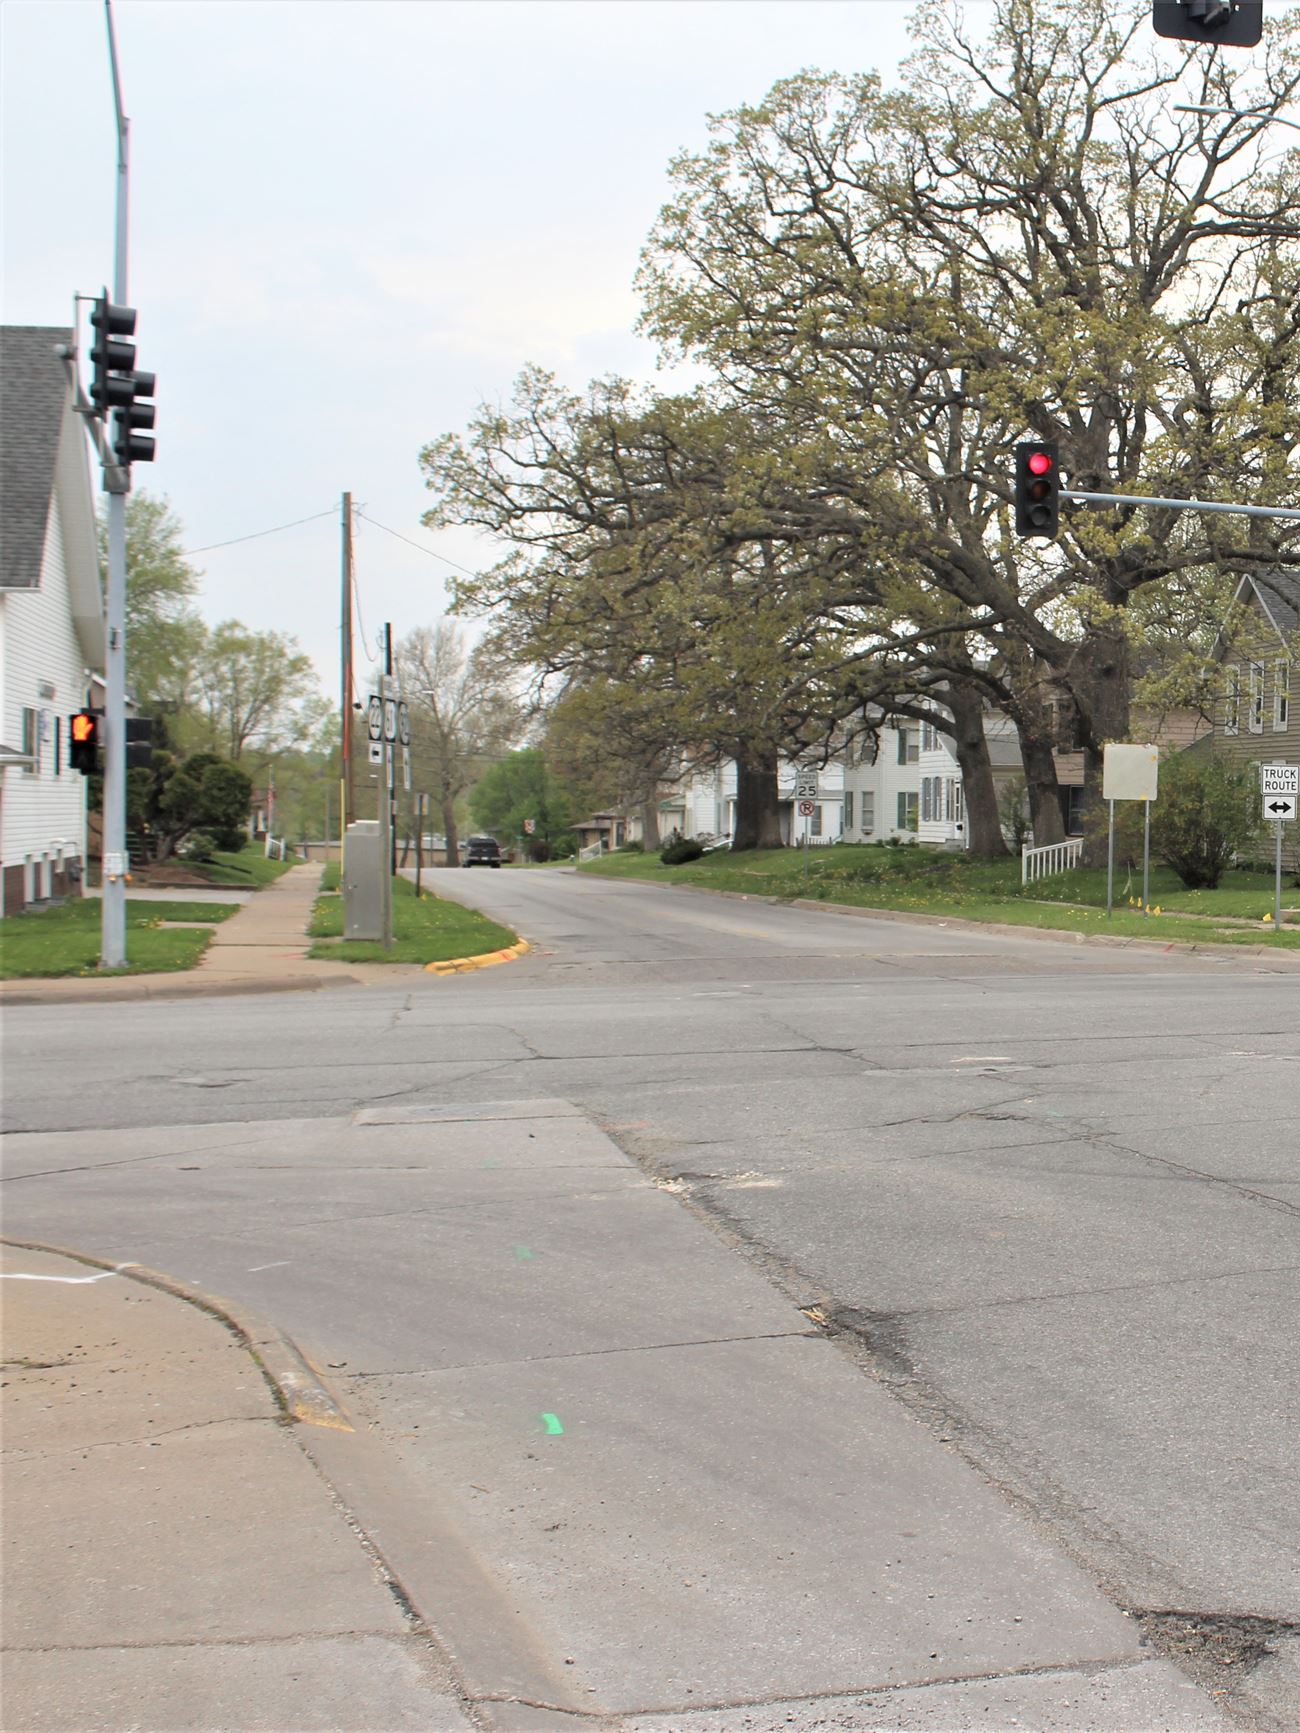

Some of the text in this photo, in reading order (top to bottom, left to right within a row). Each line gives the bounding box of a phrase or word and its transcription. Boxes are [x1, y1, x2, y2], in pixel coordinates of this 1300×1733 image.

[1264, 769, 1297, 779] TRUCK
[1264, 781, 1297, 790] ROUTE
[798, 786, 816, 797] 25
